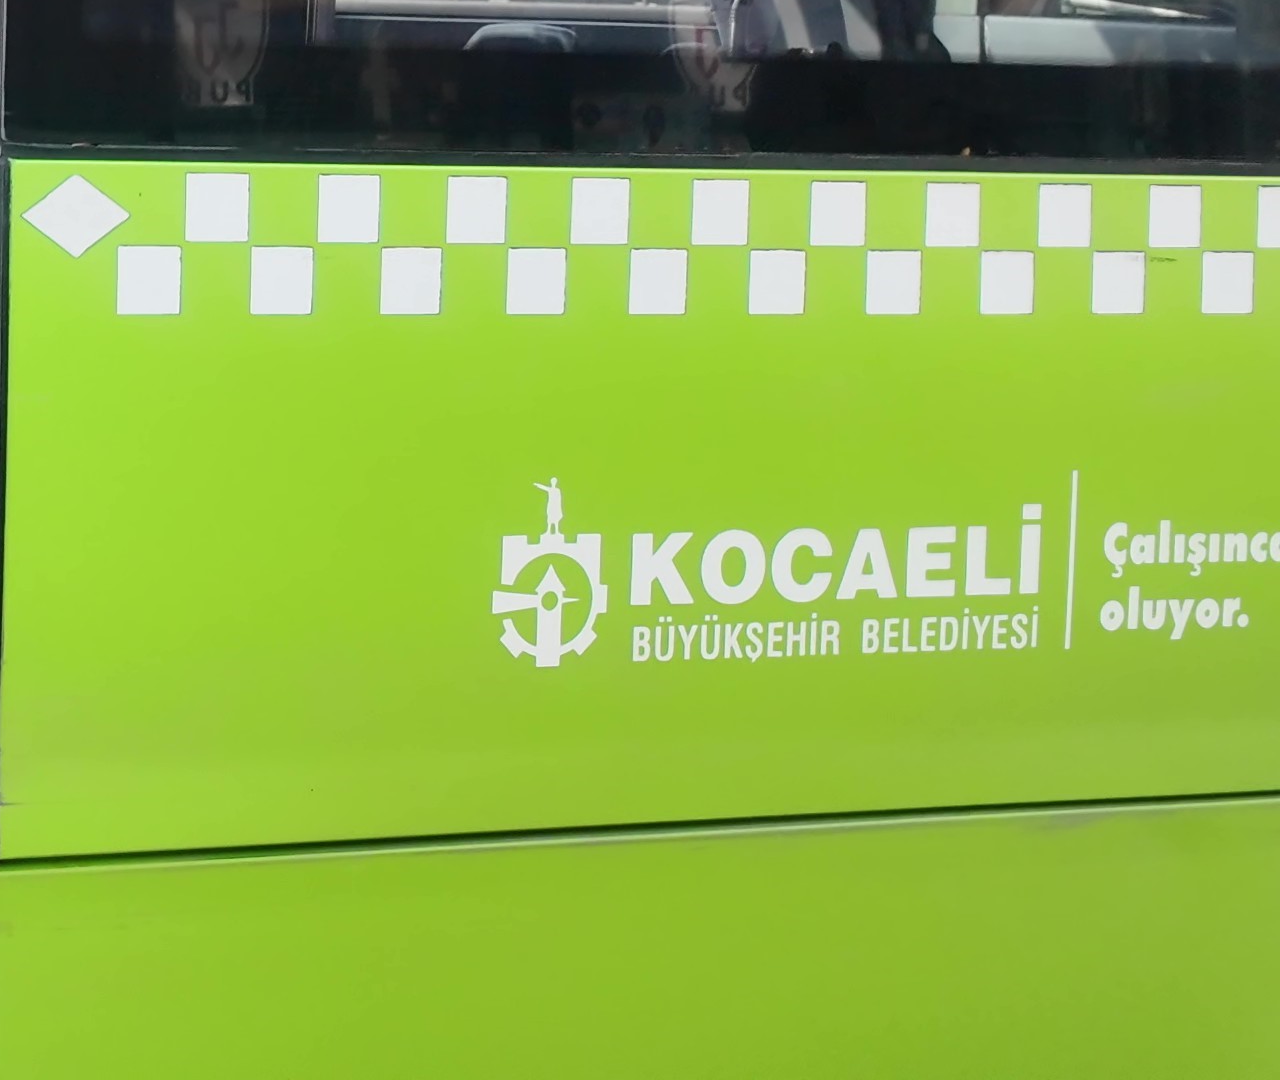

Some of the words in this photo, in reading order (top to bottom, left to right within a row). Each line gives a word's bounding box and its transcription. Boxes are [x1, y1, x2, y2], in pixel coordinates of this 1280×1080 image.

[630, 503, 1043, 606] KOCAELİ
[632, 612, 840, 663] BÜYÜKŞEHİR
[861, 605, 1039, 654] BELEDİYESİ
[1099, 585, 1250, 641] oluyor.
